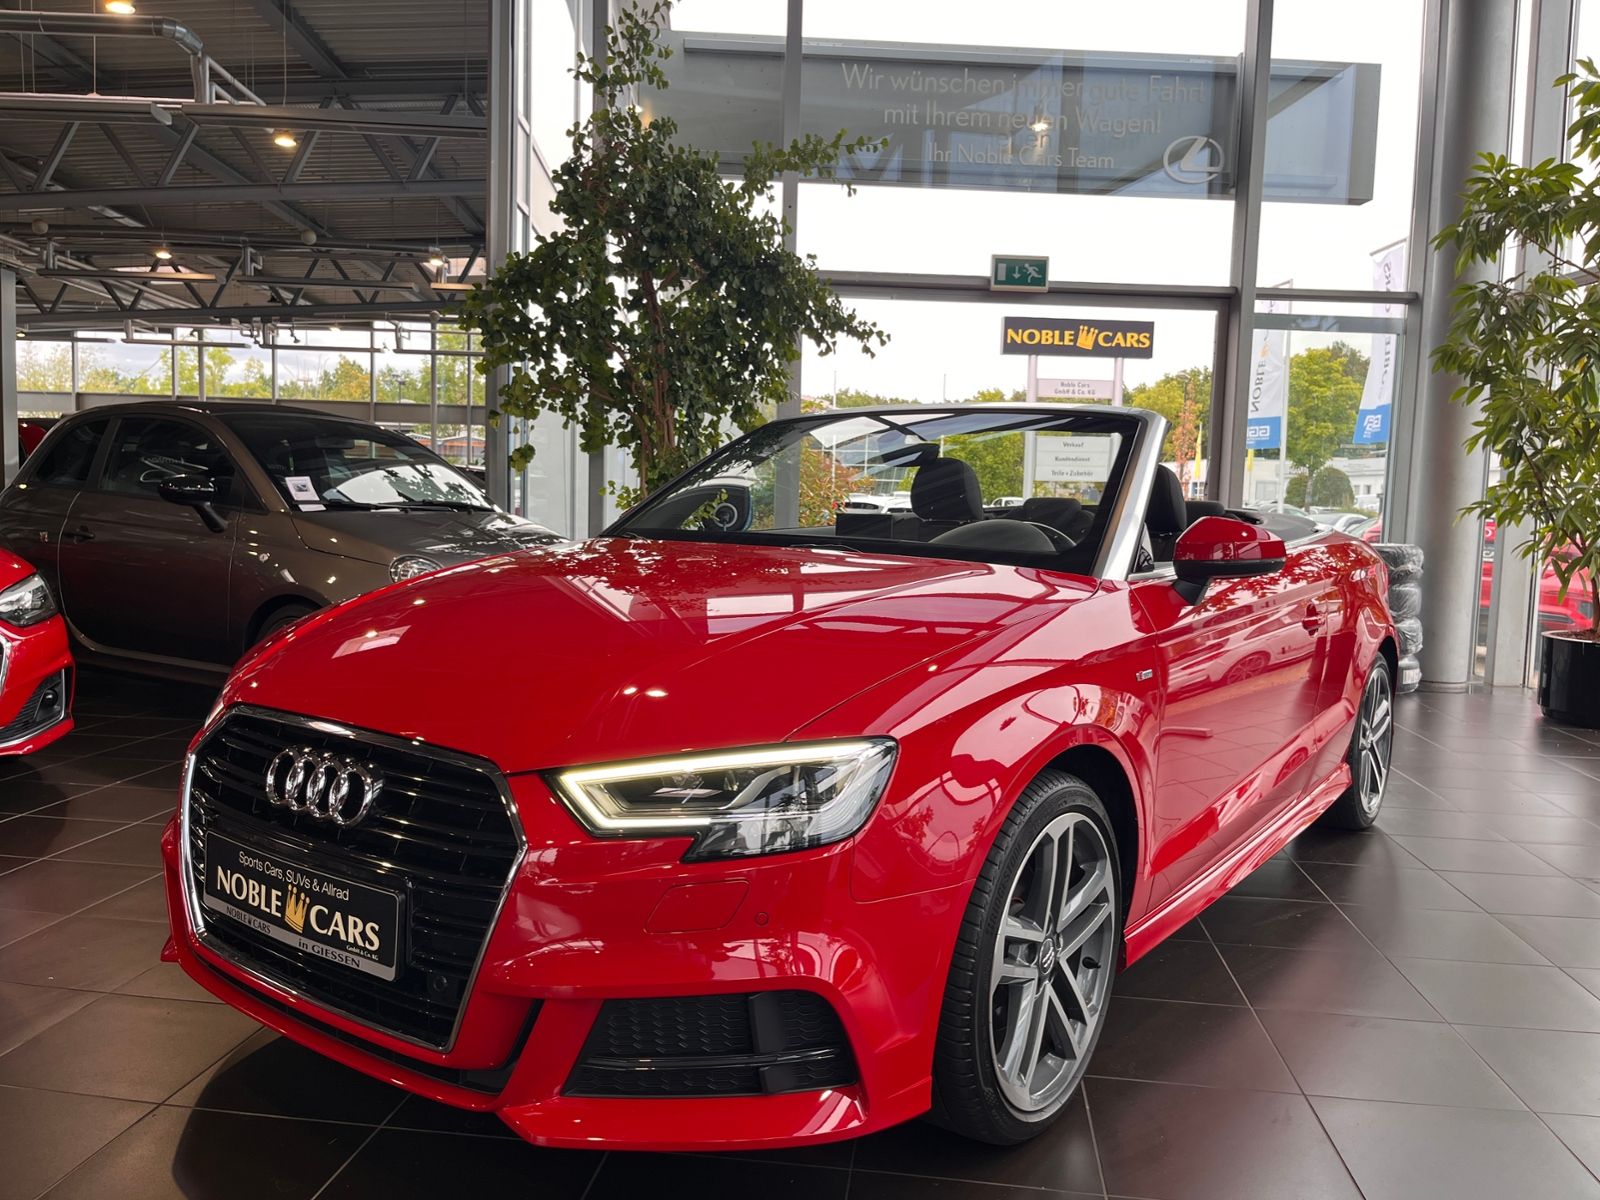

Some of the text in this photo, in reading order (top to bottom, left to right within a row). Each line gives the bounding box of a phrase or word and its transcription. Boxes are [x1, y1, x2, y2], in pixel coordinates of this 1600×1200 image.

[841, 62, 885, 90] Wir
[889, 67, 1005, 95] wünschen
[1089, 78, 1140, 105] gute
[1148, 75, 1206, 105] Fahrt
[884, 100, 1162, 138] mit Ihrem neuen Wagen!
[928, 142, 1115, 169] Ihr Noble Cars Team
[1006, 328, 1151, 348] NOBLE CARS
[239, 851, 350, 901] Sports Cars, SUVs & Allrad
[217, 865, 380, 951] NOBLE CARS
[226, 906, 271, 935] NOBLE CARS
[298, 938, 360, 968] in GIESSEN
